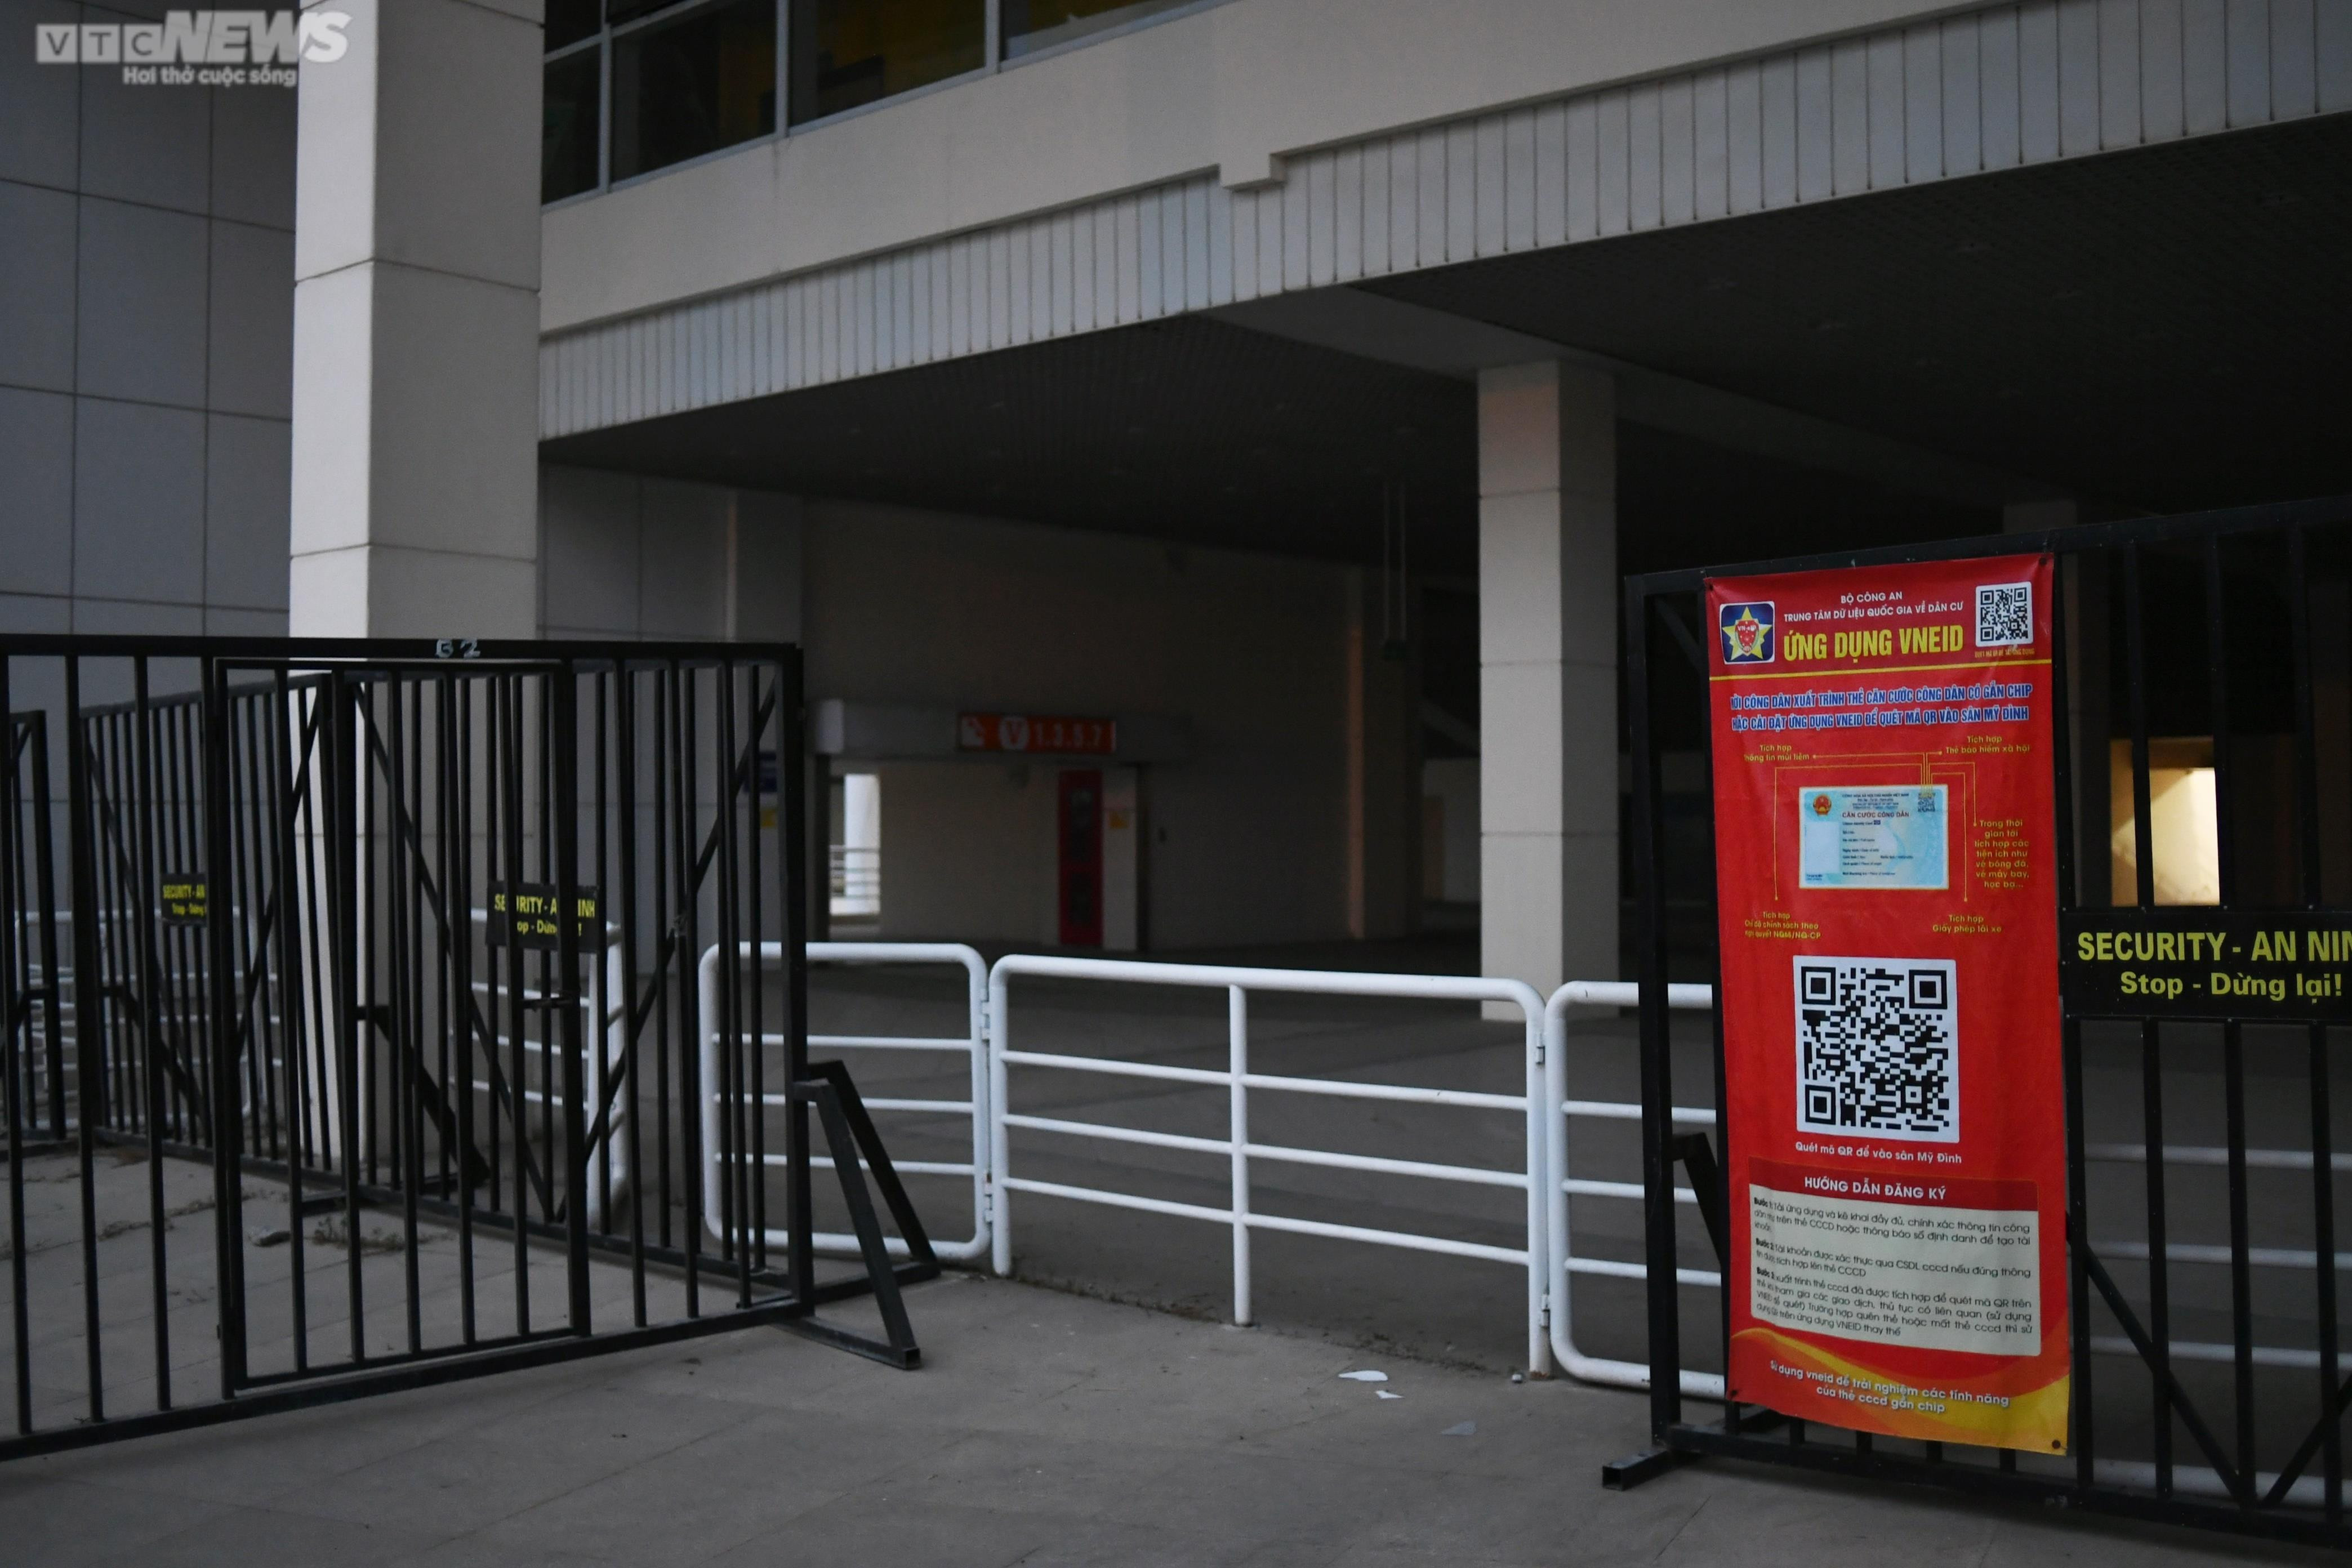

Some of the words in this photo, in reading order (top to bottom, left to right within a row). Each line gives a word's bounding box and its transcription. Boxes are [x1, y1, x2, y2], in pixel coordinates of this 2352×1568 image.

[1841, 593, 1854, 605] BỘ
[1857, 591, 1886, 602] CÔNG
[1889, 591, 1903, 600] AN
[1784, 613, 1811, 622] TRUNG
[1814, 609, 1831, 620] TÂM
[1833, 608, 1846, 618] DỮ
[1848, 607, 1864, 620] LIỆU
[1867, 604, 1894, 617] QUỐC
[1896, 605, 1912, 614] GIA
[1915, 600, 1926, 613] VỀ
[1928, 602, 1947, 612] DÂN
[1950, 602, 1963, 611] CƯ
[1784, 630, 1827, 661] ỨNG
[1834, 629, 1892, 663] DỤNG
[1899, 625, 1963, 654] VNEID
[1744, 693, 1770, 709] CÔNG
[1771, 692, 1792, 709] DÂN
[1793, 689, 1816, 708] XUẤT
[1818, 690, 1845, 707] TRÌNH
[1847, 687, 1864, 705] THẺ
[1866, 688, 1886, 703] CĂN
[1915, 685, 1942, 702] CÔNG
[1944, 684, 1967, 700] DÂN
[1967, 682, 1981, 700] CÓ
[1983, 680, 2004, 698] GẮN
[2007, 683, 2033, 697] CHIP
[1750, 714, 1767, 730] CÀI
[1768, 713, 1787, 733] ĐẶT
[1788, 711, 1807, 729] ỨNG
[1808, 714, 1834, 731] DỤNG
[1836, 712, 1863, 727] VNEID
[1864, 707, 1878, 726] ĐỂ
[1879, 710, 1903, 727] QUÉT
[1905, 709, 1921, 725] MÃ
[1922, 710, 1937, 725] QR
[1939, 706, 1959, 724] VÀO
[1961, 705, 1981, 723] SÂN
[1983, 704, 2001, 721] MỸ
[2002, 704, 2029, 721] ĐÌNH
[1980, 819, 2003, 829] Trong
[1985, 830, 2004, 839] gian
[495, 893, 544, 914] SERITY
[577, 898, 595, 918] INH
[2078, 932, 2226, 961] SECURITY
[2251, 931, 2297, 961] AN
[2121, 971, 2183, 999] Stop
[2211, 972, 2286, 1001] Dừng
[2296, 973, 2342, 1003] lại!
[1796, 1141, 1818, 1152] Quét
[1820, 1146, 1834, 1155] mã
[1838, 1146, 1852, 1156] QR
[1856, 1145, 1869, 1157] để
[1873, 1148, 1892, 1159] vào
[1895, 1150, 1913, 1160] sân
[1918, 1152, 1933, 1164] Mỹ
[1937, 1152, 1962, 1163] Đình
[1805, 1176, 1848, 1192] HƯỚNG
[1853, 1178, 1880, 1195] DẪN
[1885, 1183, 1923, 1199] ĐĂNG
[1929, 1186, 1946, 1200] KÝ
[1803, 1208, 1824, 1219] dụng
[1850, 1212, 1869, 1222] khai
[1908, 1218, 1934, 1228] chính
[1937, 1220, 1954, 1229] xác
[1958, 1221, 1986, 1232] thông
[1989, 1223, 2001, 1232] tin
[2003, 1223, 2030, 1234] công
[1809, 1219, 1834, 1231] CCCD
[1863, 1225, 1889, 1238] thông
[1892, 1229, 1911, 1239] báo
[1951, 1233, 1977, 1243] danh
[1980, 1234, 1994, 1245] để
[1838, 1266, 1867, 1277] CCCD
[1876, 1259, 1894, 1268] qua
[1896, 1260, 1919, 1271] CSDL
[1922, 1263, 1948, 1273] cccd
[1972, 1266, 1998, 1278] đúng
[2001, 1268, 2030, 1279] thông
[1828, 1282, 1849, 1293] cccd
[1911, 1291, 1931, 1303] hợp
[1949, 1295, 1972, 1306] quét
[1994, 1298, 2009, 1308] QR
[2012, 1299, 2032, 1308] trên
[1902, 1316, 1927, 1328] hoặc
[1975, 1324, 2001, 1333] cccd
[1917, 1304, 1931, 1314] có
[1935, 1306, 1952, 1316] liên
[1956, 1309, 1982, 1319] quan
[2005, 1311, 2032, 1323] dụng
[1836, 1321, 1861, 1331] VNEID
[1864, 1324, 1883, 1335] thay
[1779, 1365, 1803, 1379] dụng
[1806, 1371, 1833, 1383] vneid
[1837, 1374, 1850, 1386] để
[1853, 1378, 1872, 1389] trải
[1875, 1383, 1918, 1395] nghiệm
[1922, 1388, 1946, 1398] các
[1950, 1389, 1972, 1401] tính
[1976, 1394, 2010, 1407] năng
[1816, 1385, 1836, 1397] của
[1838, 1389, 1855, 1400] thẻ
[1859, 1395, 1888, 1405] cccd
[1891, 1396, 1914, 1409] gắn
[1918, 1402, 1945, 1414] chip
